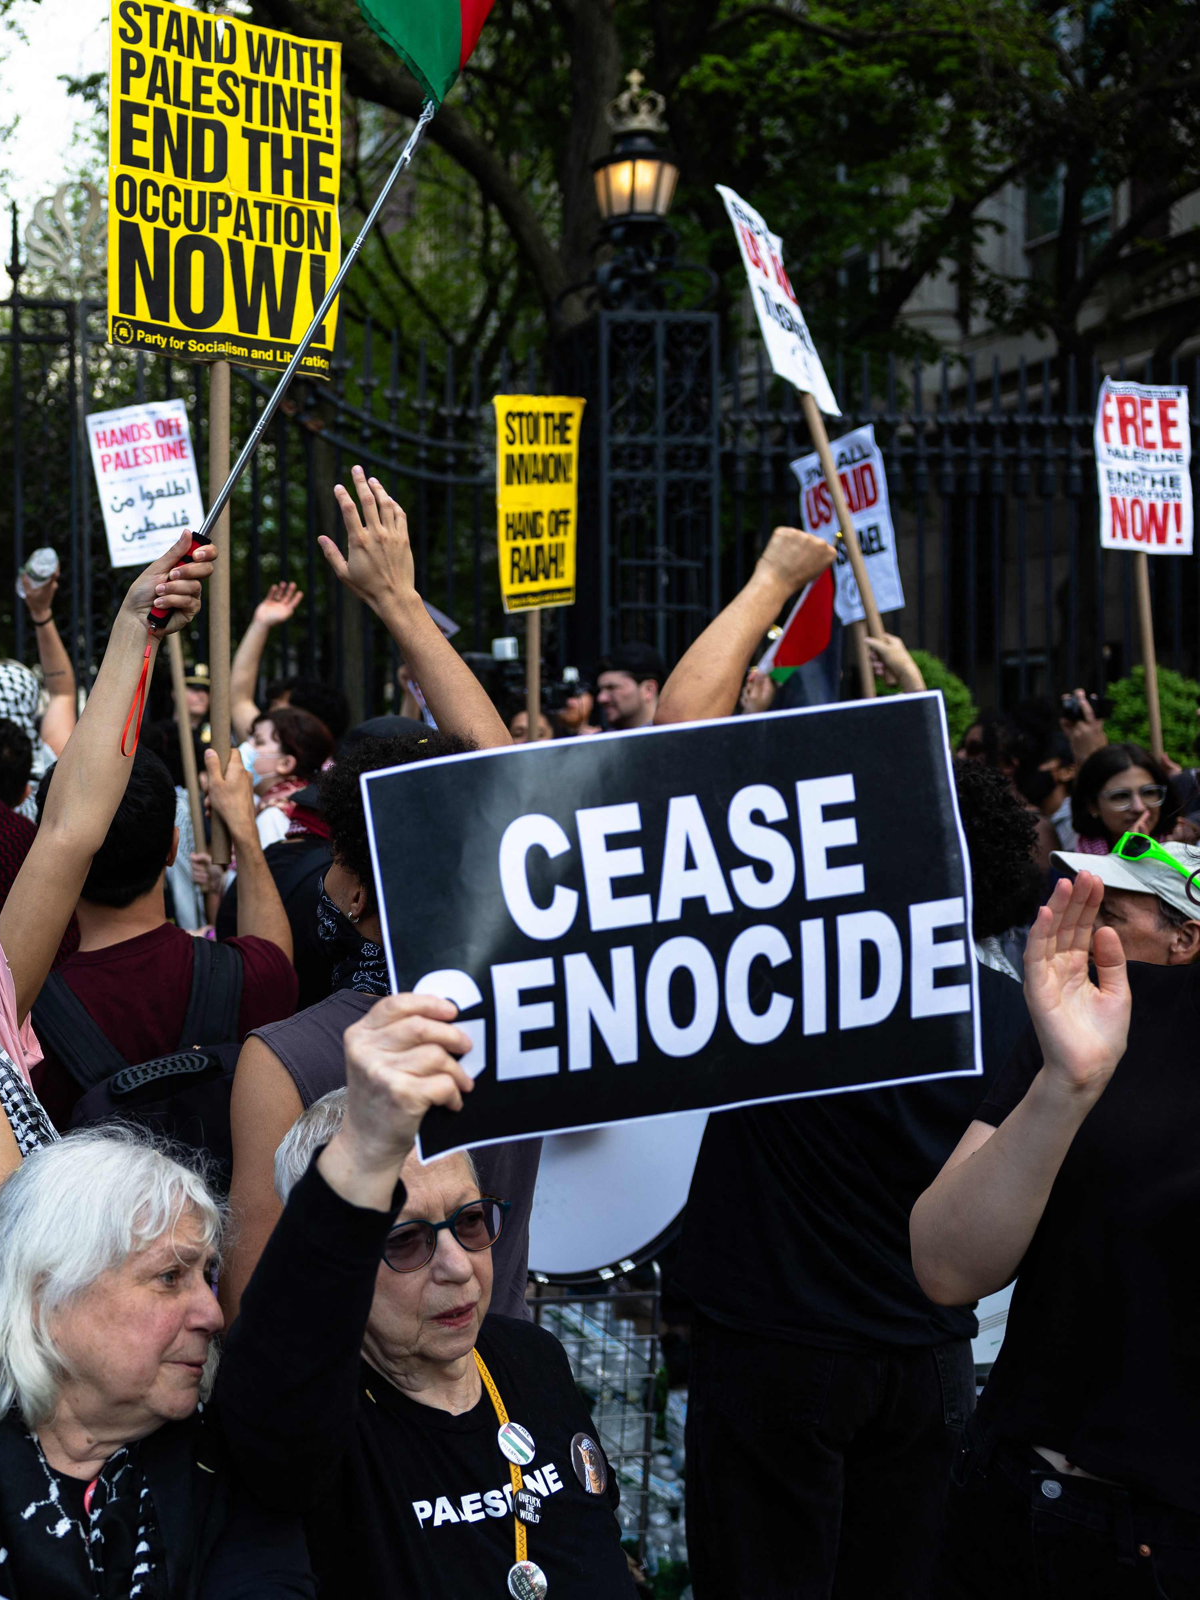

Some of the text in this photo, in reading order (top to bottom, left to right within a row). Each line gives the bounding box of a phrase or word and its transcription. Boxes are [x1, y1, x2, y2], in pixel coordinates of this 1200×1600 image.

[118, 0, 334, 91] STAND WITH
[120, 47, 334, 140] PALESTINE!
[119, 98, 336, 206] END THE
[115, 173, 332, 253] OCCUPATION
[118, 218, 327, 346] NOW!
[136, 329, 168, 349] Party
[169, 335, 186, 350] for
[187, 339, 249, 358] Socialism
[250, 348, 274, 362] and
[94, 416, 183, 449] HANDS OFF
[1102, 392, 1183, 450] FREE
[100, 438, 189, 473] PALESTINE
[110, 477, 192, 513] اطلعوا من
[122, 509, 191, 543] فلسطين
[1110, 496, 1183, 545] NOW!
[499, 773, 866, 941] CEASE
[412, 896, 972, 1082] GENOCIDE
[518, 1492, 542, 1509] UNFUCK
[519, 1508, 540, 1524] WORLD
[525, 1503, 535, 1514] THE
[520, 1577, 532, 1592] ONE
